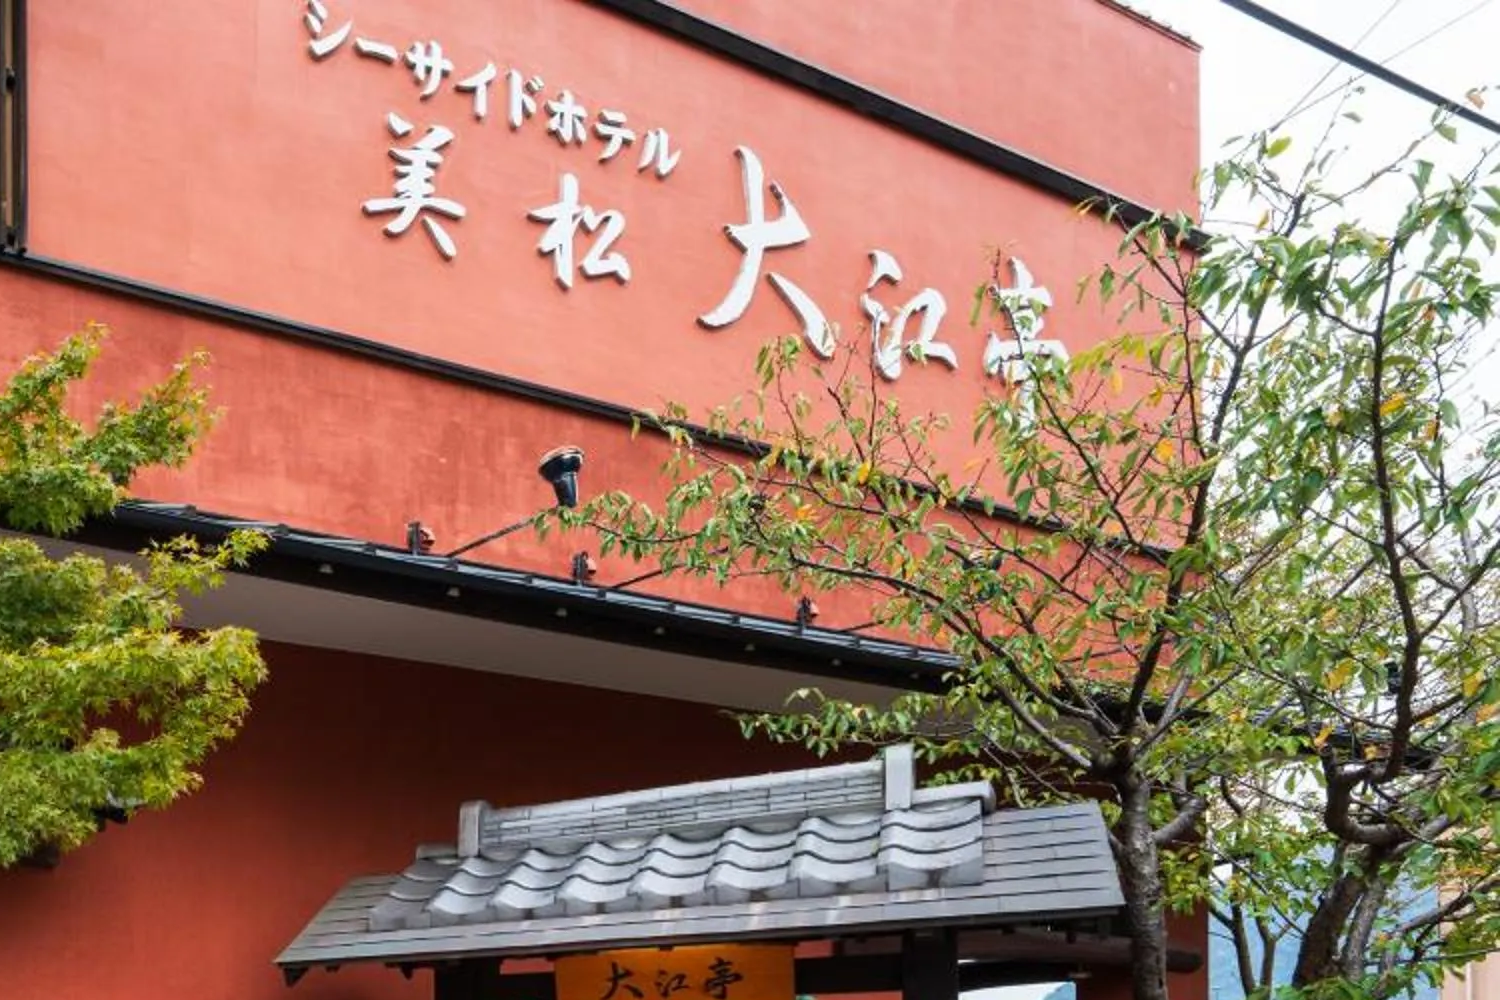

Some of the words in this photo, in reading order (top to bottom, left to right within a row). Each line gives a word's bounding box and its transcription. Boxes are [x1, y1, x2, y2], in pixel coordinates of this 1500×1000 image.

[304, 1, 681, 180] シーサイドホテル
[362, 111, 632, 290] 美松
[600, 956, 744, 1000] 大江亭
